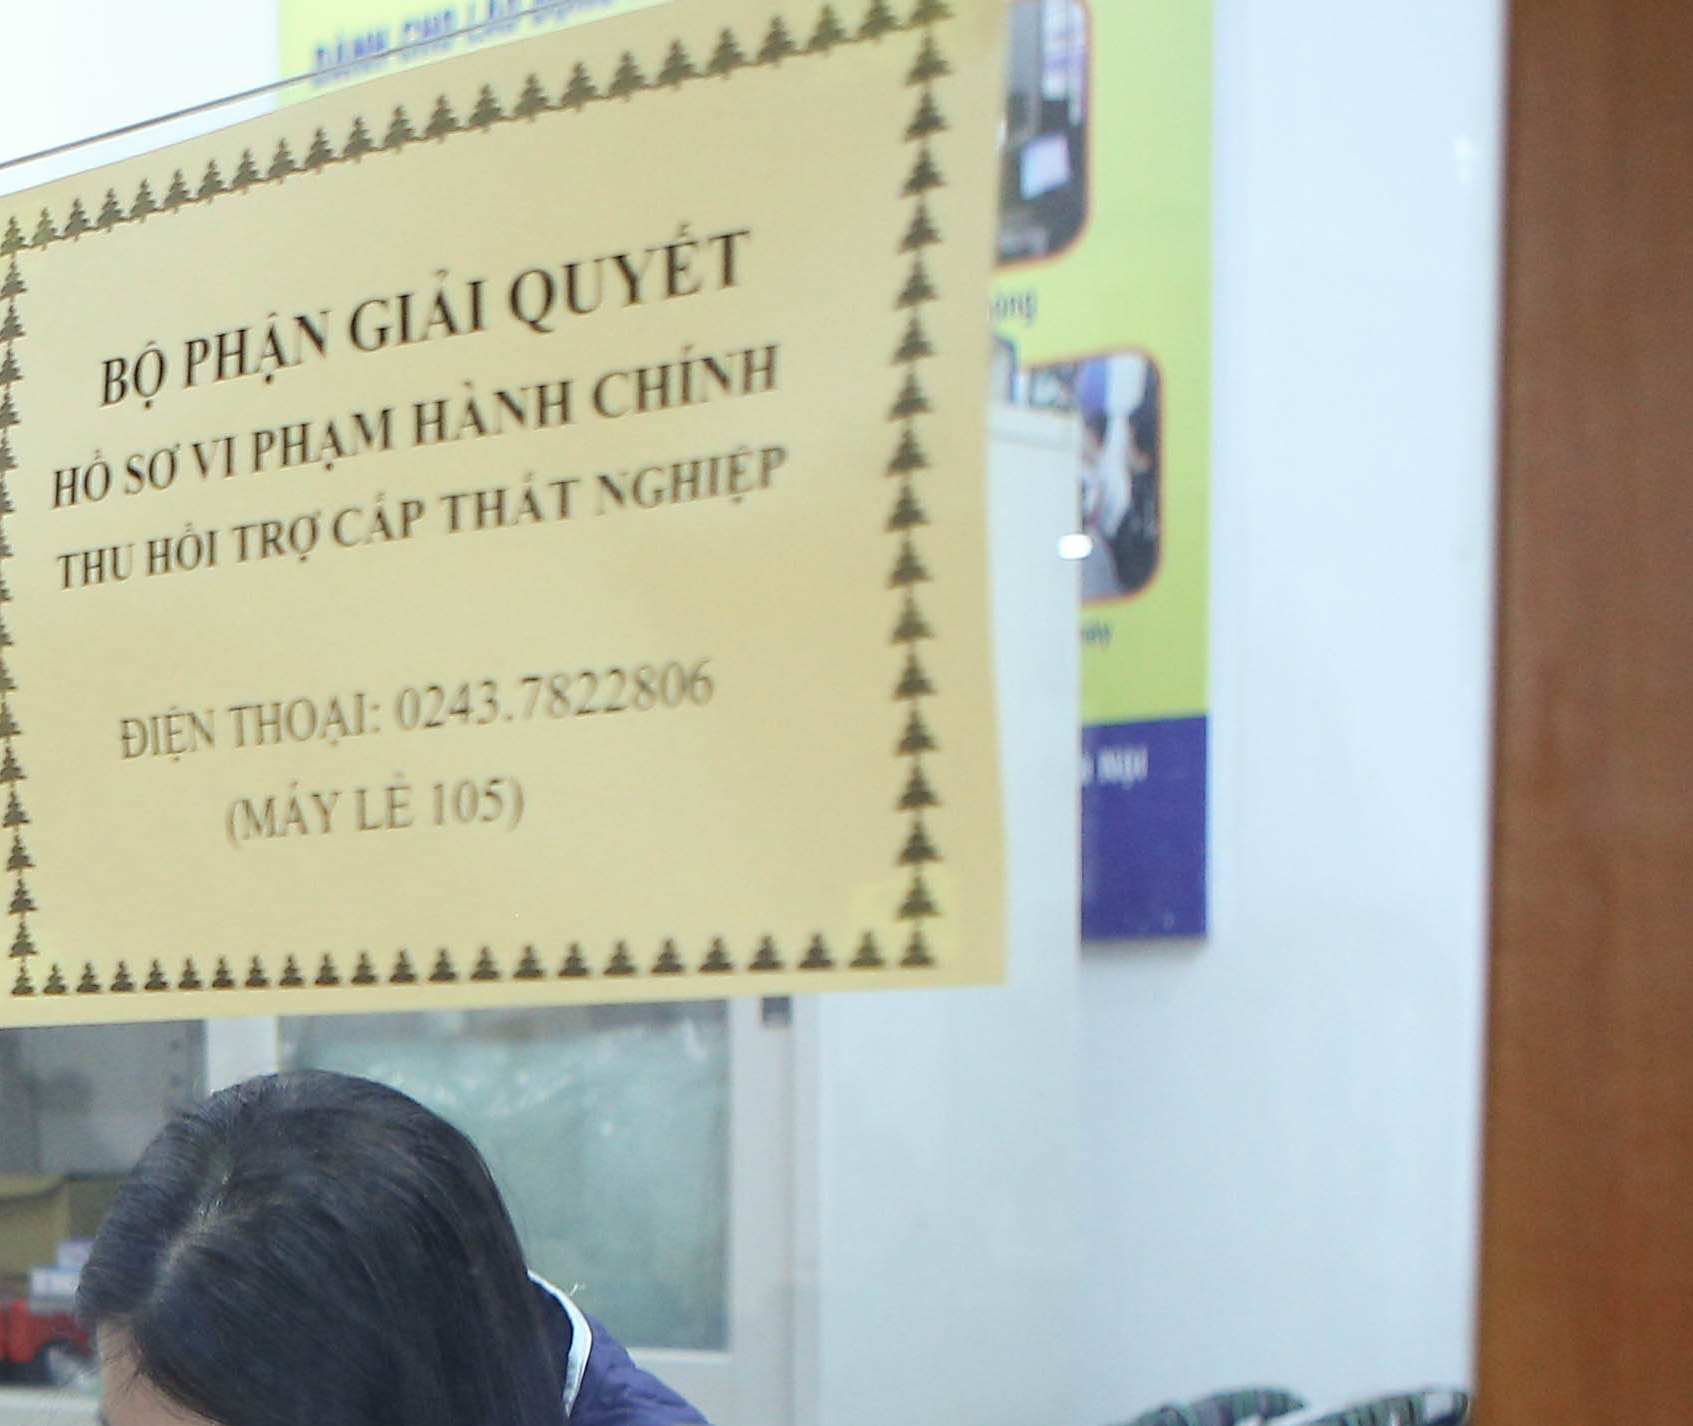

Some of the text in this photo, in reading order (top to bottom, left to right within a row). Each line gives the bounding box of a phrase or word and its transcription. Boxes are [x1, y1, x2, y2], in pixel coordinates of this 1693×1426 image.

[98, 221, 752, 410] BỘ PHẬN GIẢI QUYẾT
[124, 441, 182, 496] SƠ
[191, 434, 239, 480] VI
[251, 406, 396, 473] PHẠM
[410, 379, 575, 448] HÀNH
[591, 343, 781, 419] CHÍNH
[55, 543, 135, 592] THU
[230, 509, 323, 564] TRỢ
[331, 490, 427, 549] CẤP
[440, 471, 582, 534] THẤT
[594, 444, 789, 516] NGHIỆP
[118, 657, 715, 764] ĐIỆN THOẠI: 0243.7822806
[224, 770, 526, 850] (MÁY LẺ 105)
